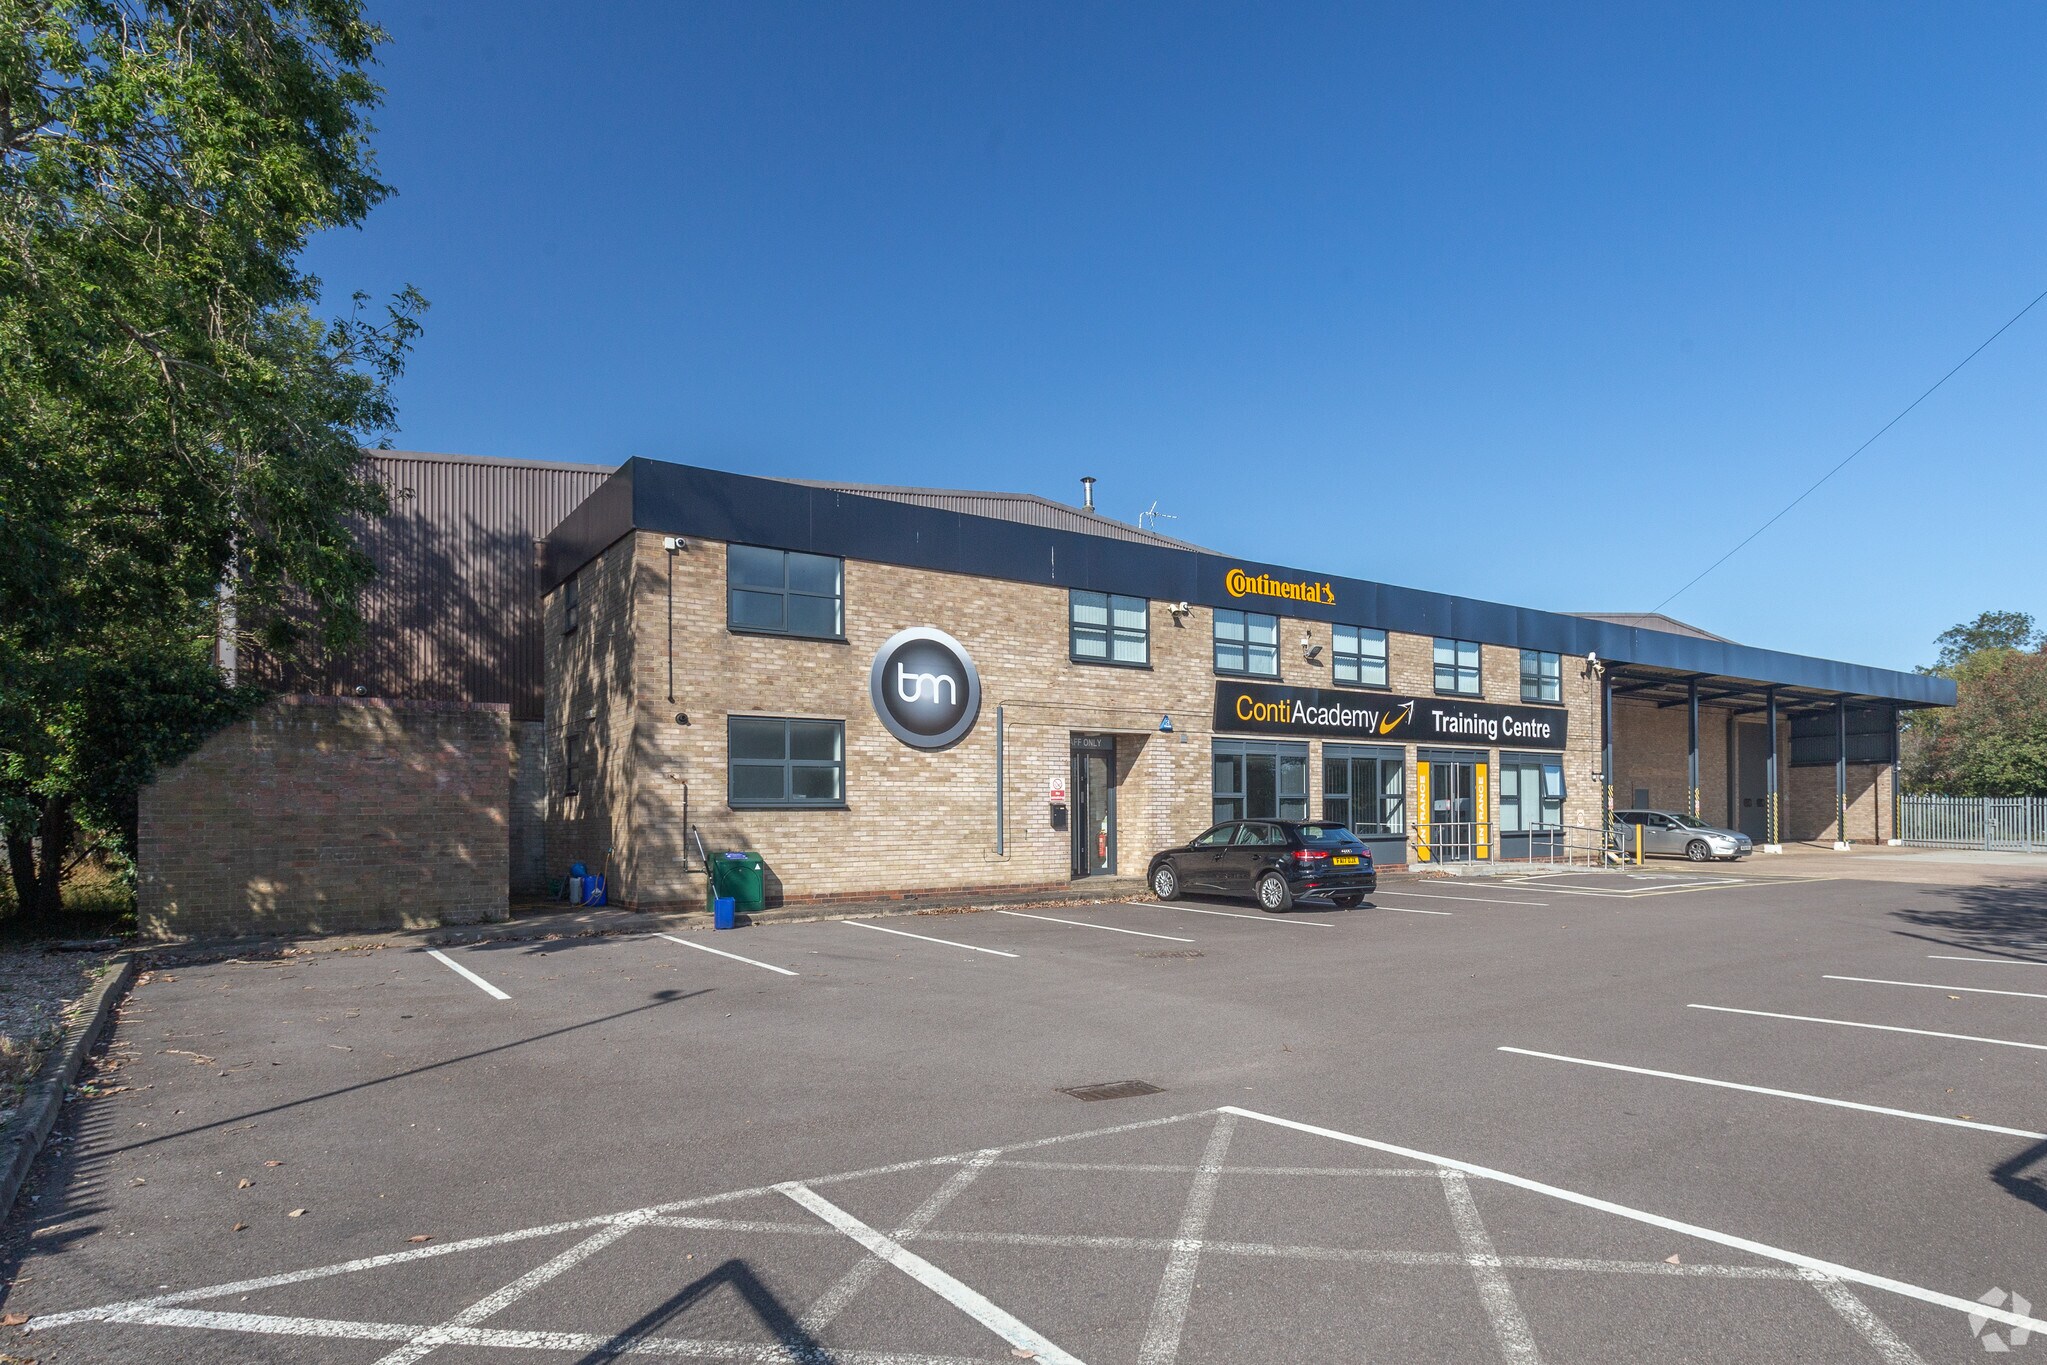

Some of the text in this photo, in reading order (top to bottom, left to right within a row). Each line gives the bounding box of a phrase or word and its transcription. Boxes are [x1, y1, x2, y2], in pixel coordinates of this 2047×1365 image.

[1225, 568, 1322, 603] Continental
[1236, 694, 1379, 734] ContiAcademy
[1431, 709, 1551, 740] Training Centre
[1083, 738, 1102, 747] ONLY
